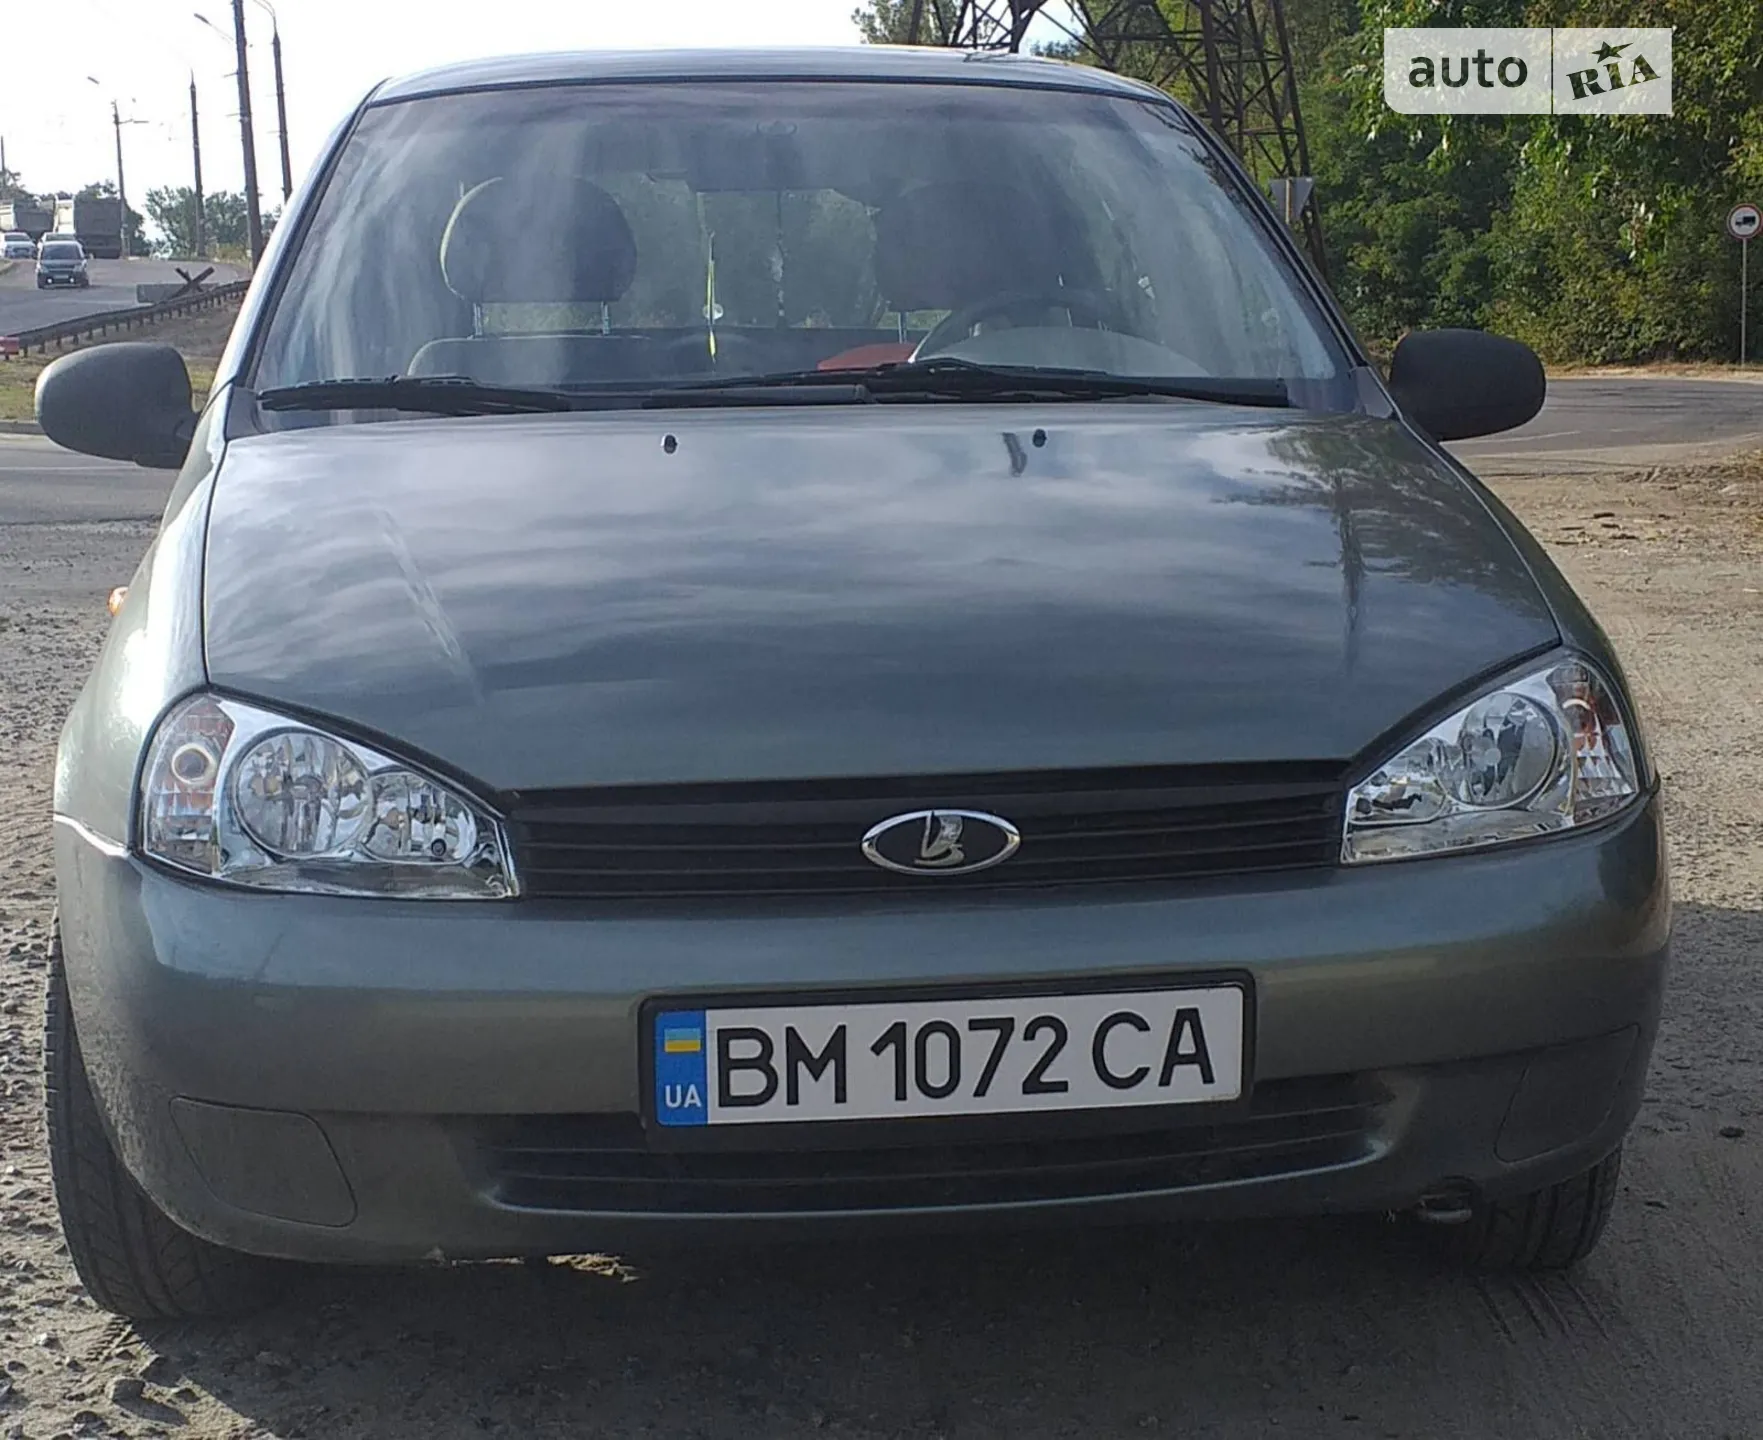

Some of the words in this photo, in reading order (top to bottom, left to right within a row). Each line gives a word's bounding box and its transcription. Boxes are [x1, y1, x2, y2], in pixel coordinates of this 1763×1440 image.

[716, 1024, 847, 1107] BM
[870, 1015, 1069, 1102] 1072
[1092, 1007, 1215, 1090] CA
[665, 1083, 702, 1109] UA
